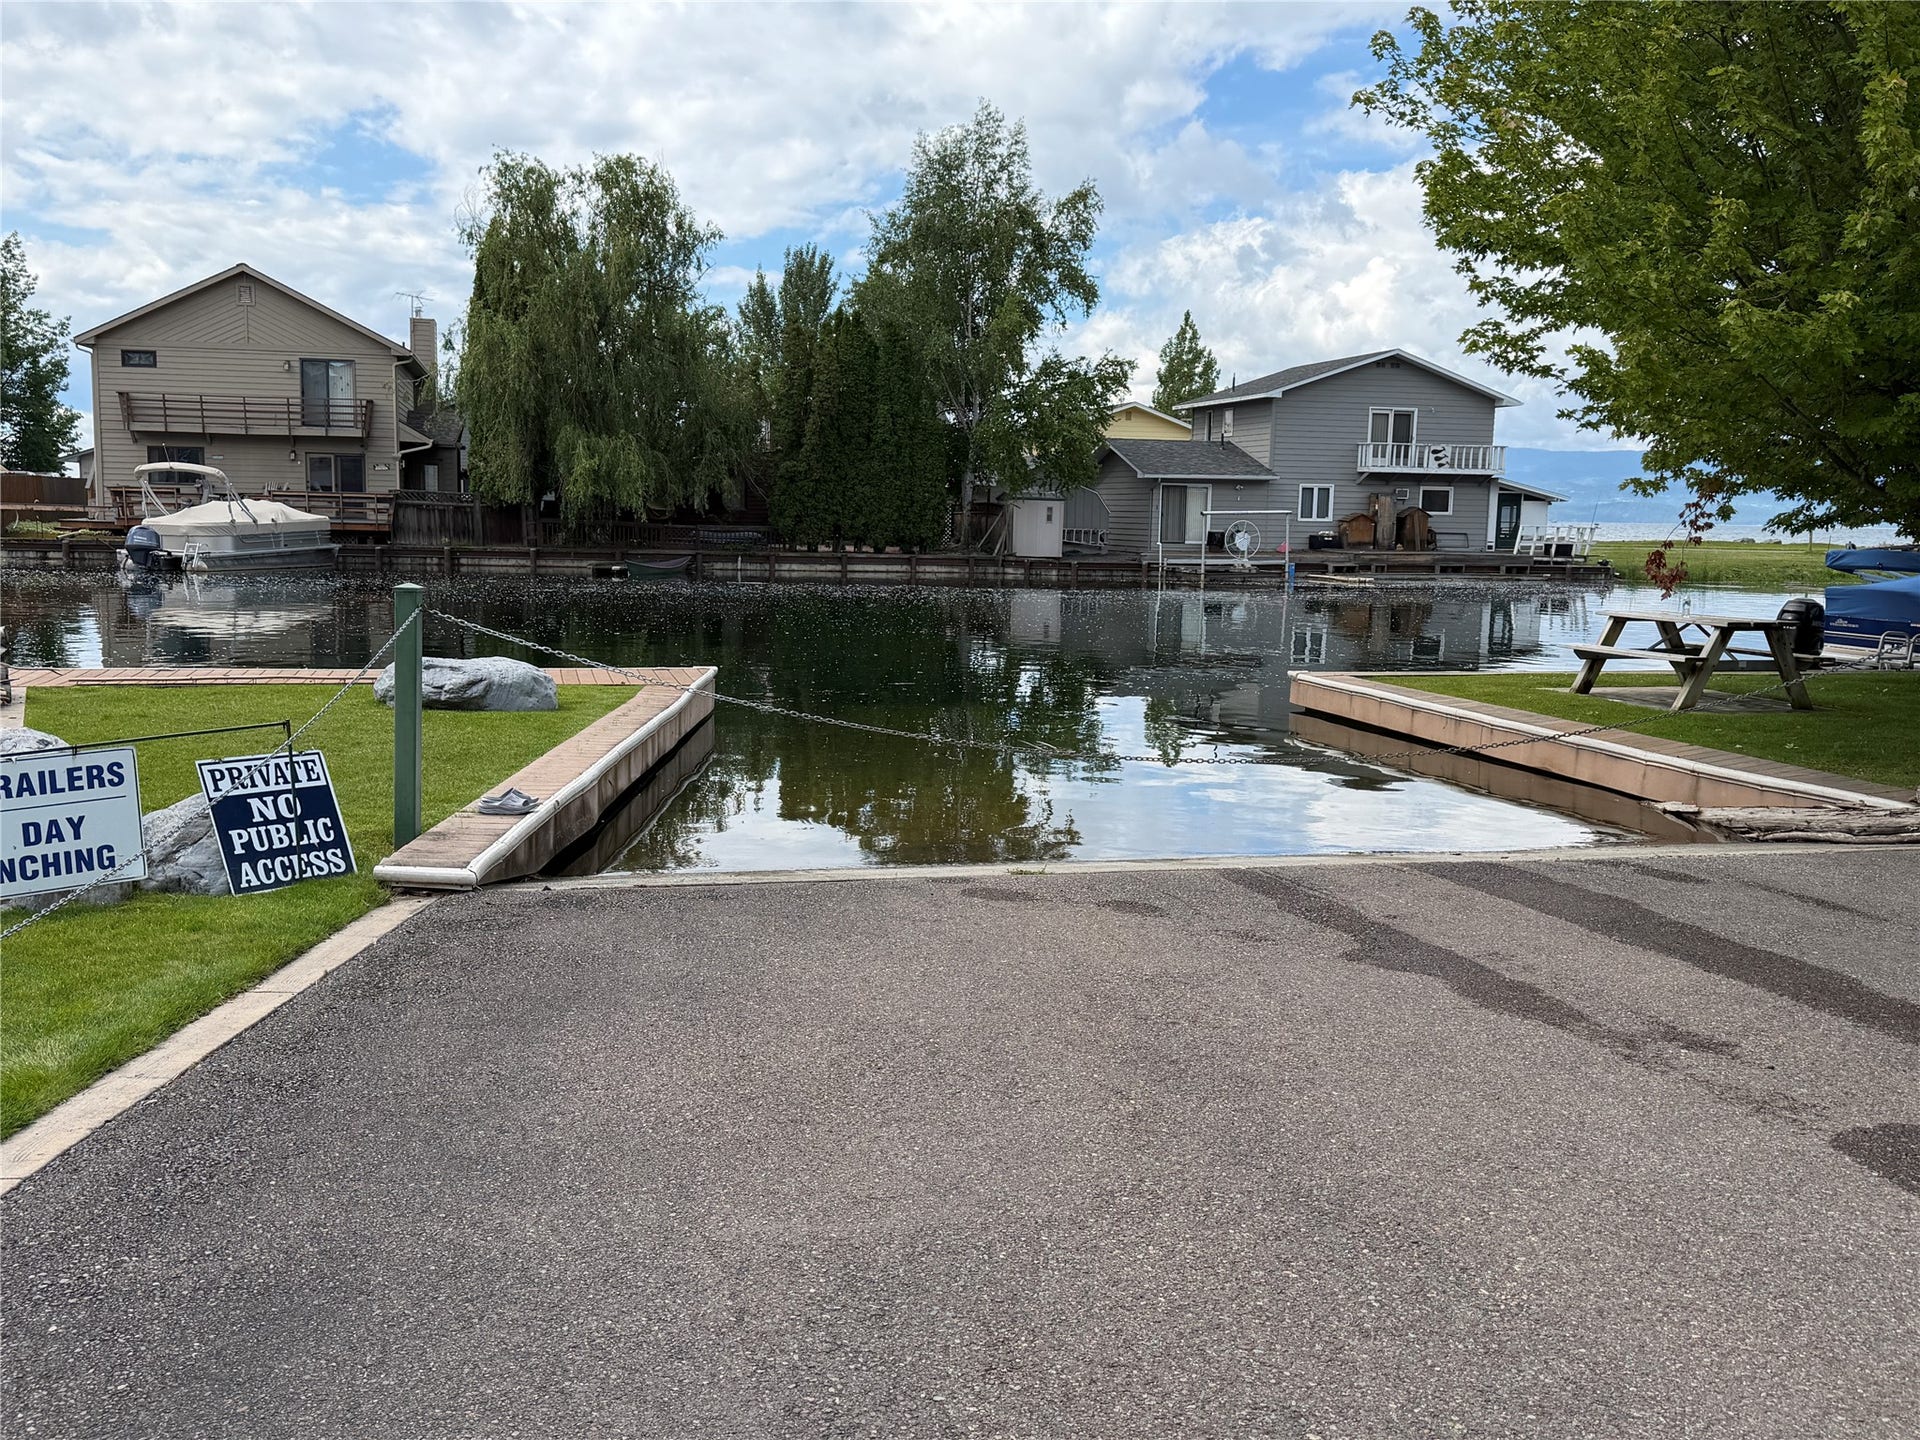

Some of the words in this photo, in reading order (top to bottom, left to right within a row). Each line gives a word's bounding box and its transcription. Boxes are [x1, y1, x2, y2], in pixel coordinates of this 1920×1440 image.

[208, 759, 321, 792] PRIVATE
[247, 794, 302, 822] NO
[22, 815, 85, 847] DAY
[228, 817, 335, 855] PUBLIC
[240, 848, 346, 888] ACCESS
